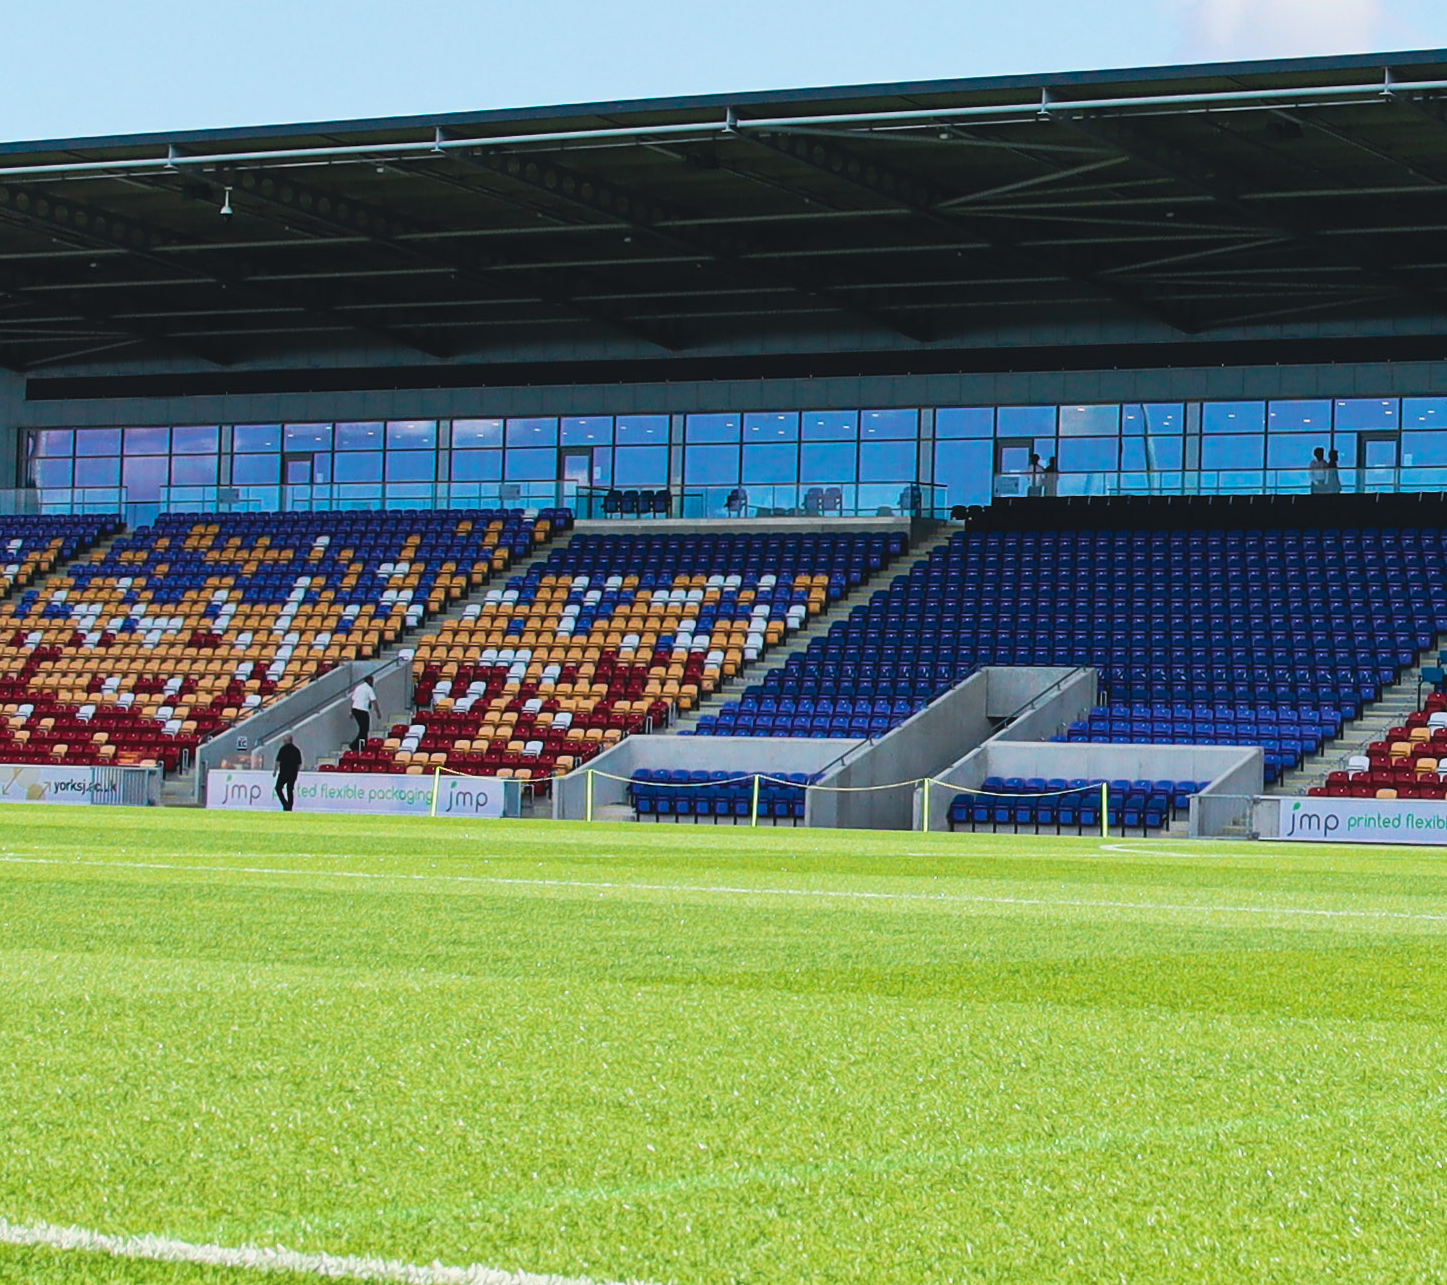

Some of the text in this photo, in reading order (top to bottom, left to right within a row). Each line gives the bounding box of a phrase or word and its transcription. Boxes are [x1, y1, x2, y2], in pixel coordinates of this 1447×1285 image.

[222, 774, 262, 805] jmp
[272, 782, 433, 805] pted flexible packaging
[446, 781, 488, 812] jmp
[1287, 802, 1339, 837] jmp
[1347, 811, 1402, 831] printed
